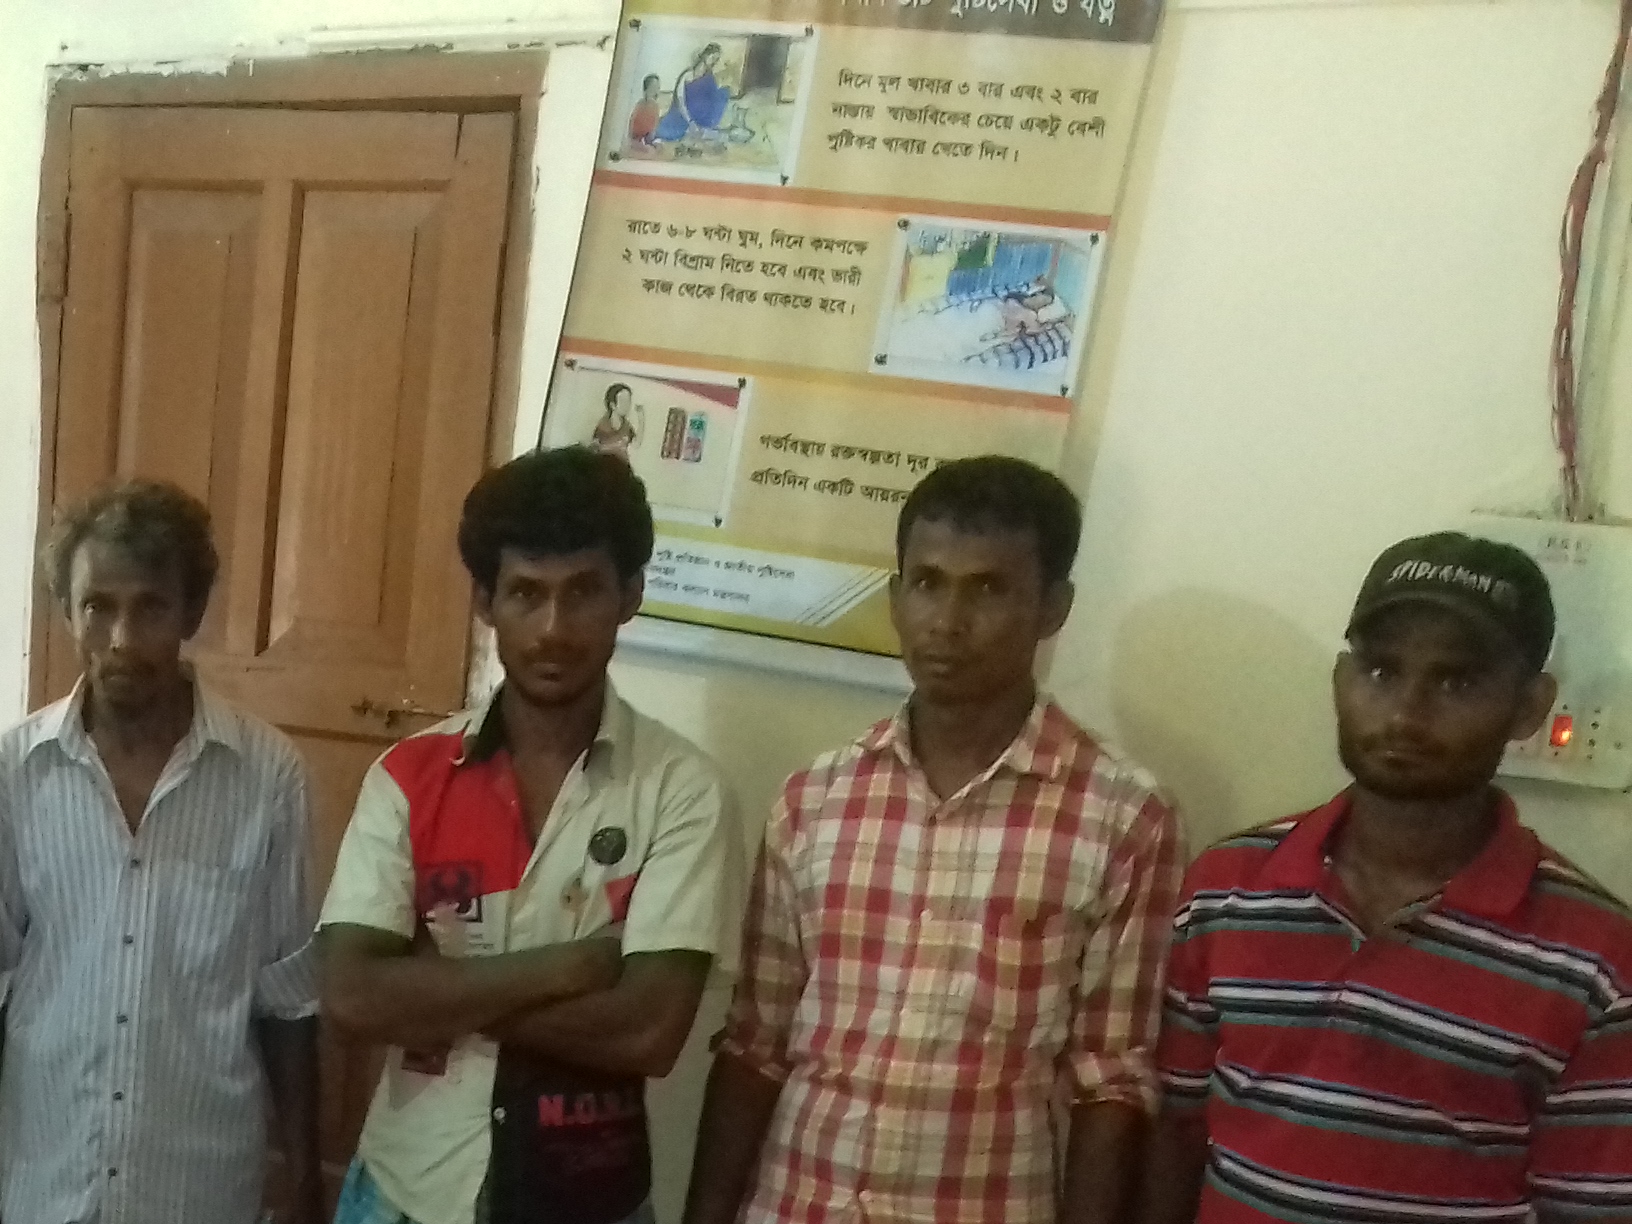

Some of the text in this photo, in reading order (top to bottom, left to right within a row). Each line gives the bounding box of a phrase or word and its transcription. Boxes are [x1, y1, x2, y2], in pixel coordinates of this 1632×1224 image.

[838, 68, 873, 88] দিনে
[908, 77, 953, 95] খাবার
[977, 81, 1005, 99] বার
[1010, 85, 1044, 103] এবং
[626, 219, 662, 235] রাতে
[771, 228, 804, 249] দিনে
[721, 254, 754, 274] নিতে
[760, 260, 788, 278] হবে
